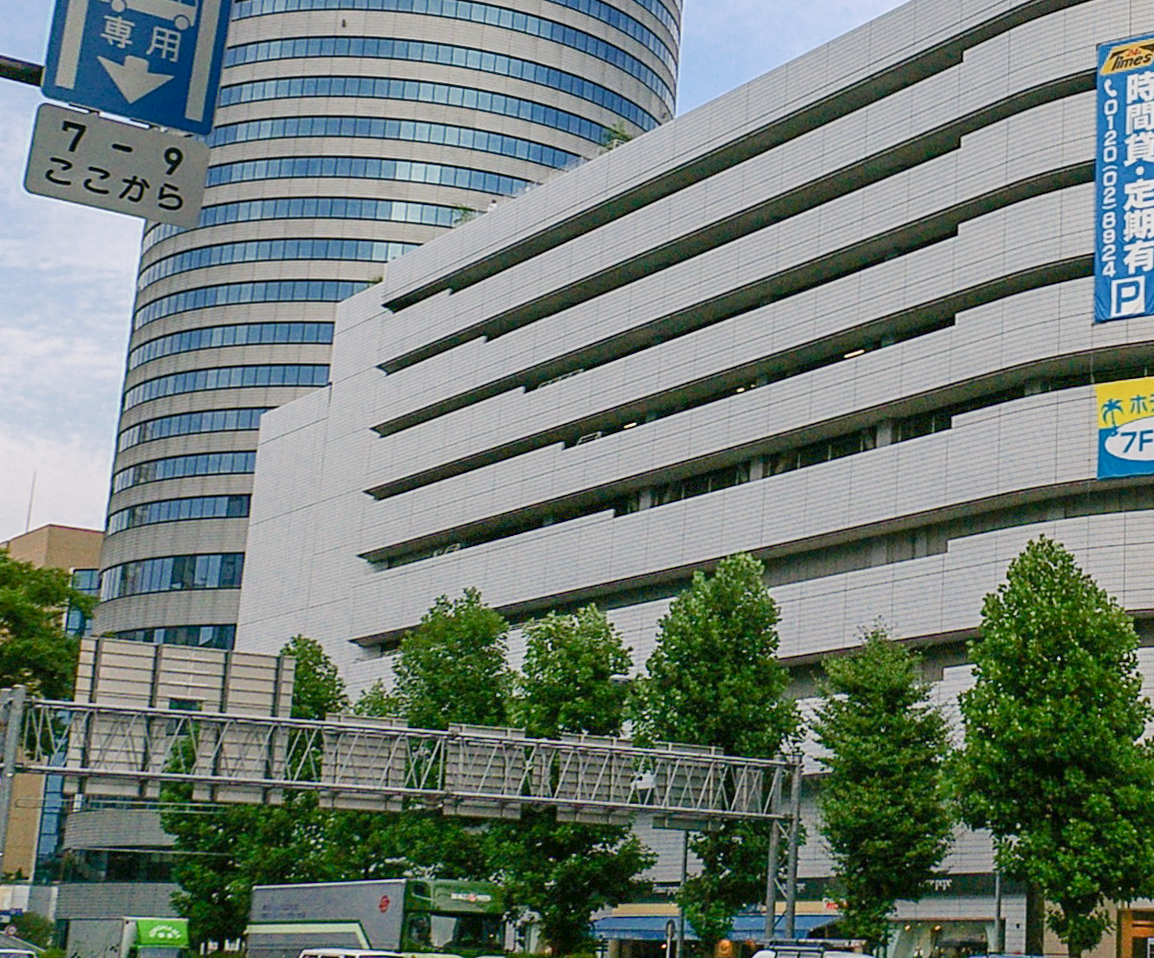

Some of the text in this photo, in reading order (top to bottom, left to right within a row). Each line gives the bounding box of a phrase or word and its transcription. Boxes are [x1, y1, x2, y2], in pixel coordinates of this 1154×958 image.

[100, 15, 182, 64] 専用
[1110, 52, 1154, 72] Times
[44, 156, 184, 211] ここから
